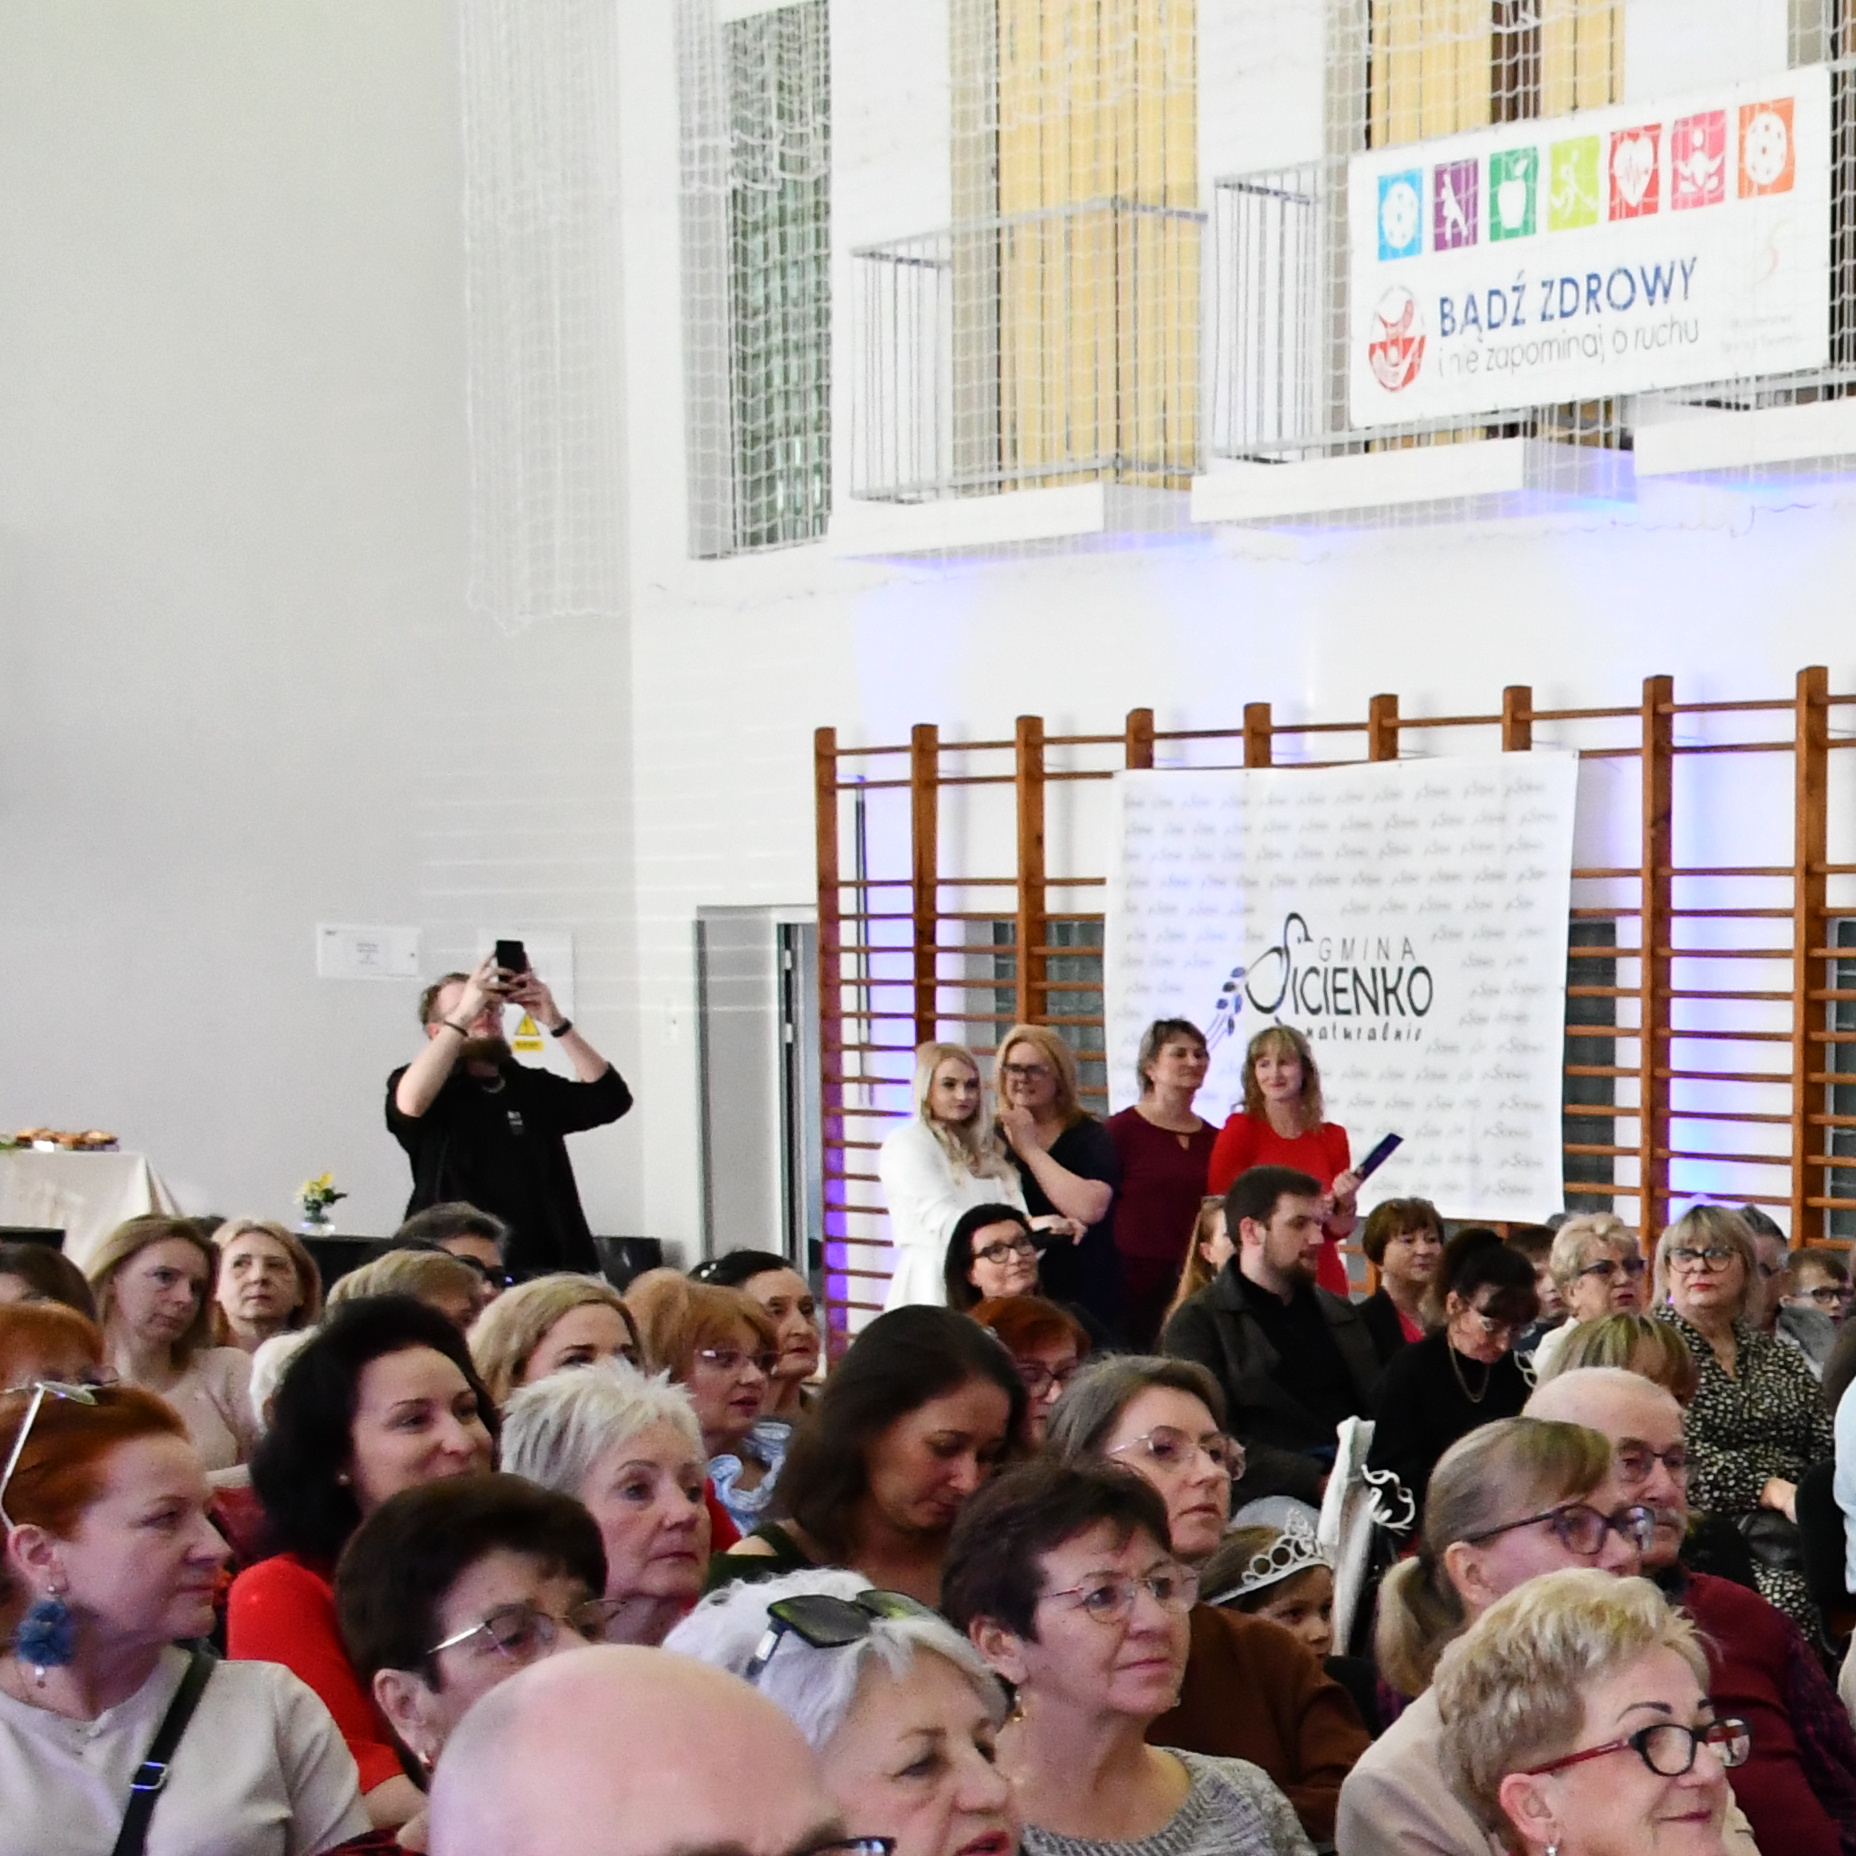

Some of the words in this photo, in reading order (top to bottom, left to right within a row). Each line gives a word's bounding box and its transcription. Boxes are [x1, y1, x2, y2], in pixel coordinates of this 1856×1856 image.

[1440, 270, 1525, 343] BĄDŹ
[1541, 257, 1697, 321] ZDROWY
[1450, 343, 1479, 375] ne
[1486, 324, 1605, 374] zapominaj
[1612, 329, 1627, 354] o
[1634, 315, 1701, 350] ruchu
[1244, 912, 1433, 1024] SICIENKO
[1318, 936, 1417, 962] GMINA
[1306, 1022, 1422, 1042] naturalnie
